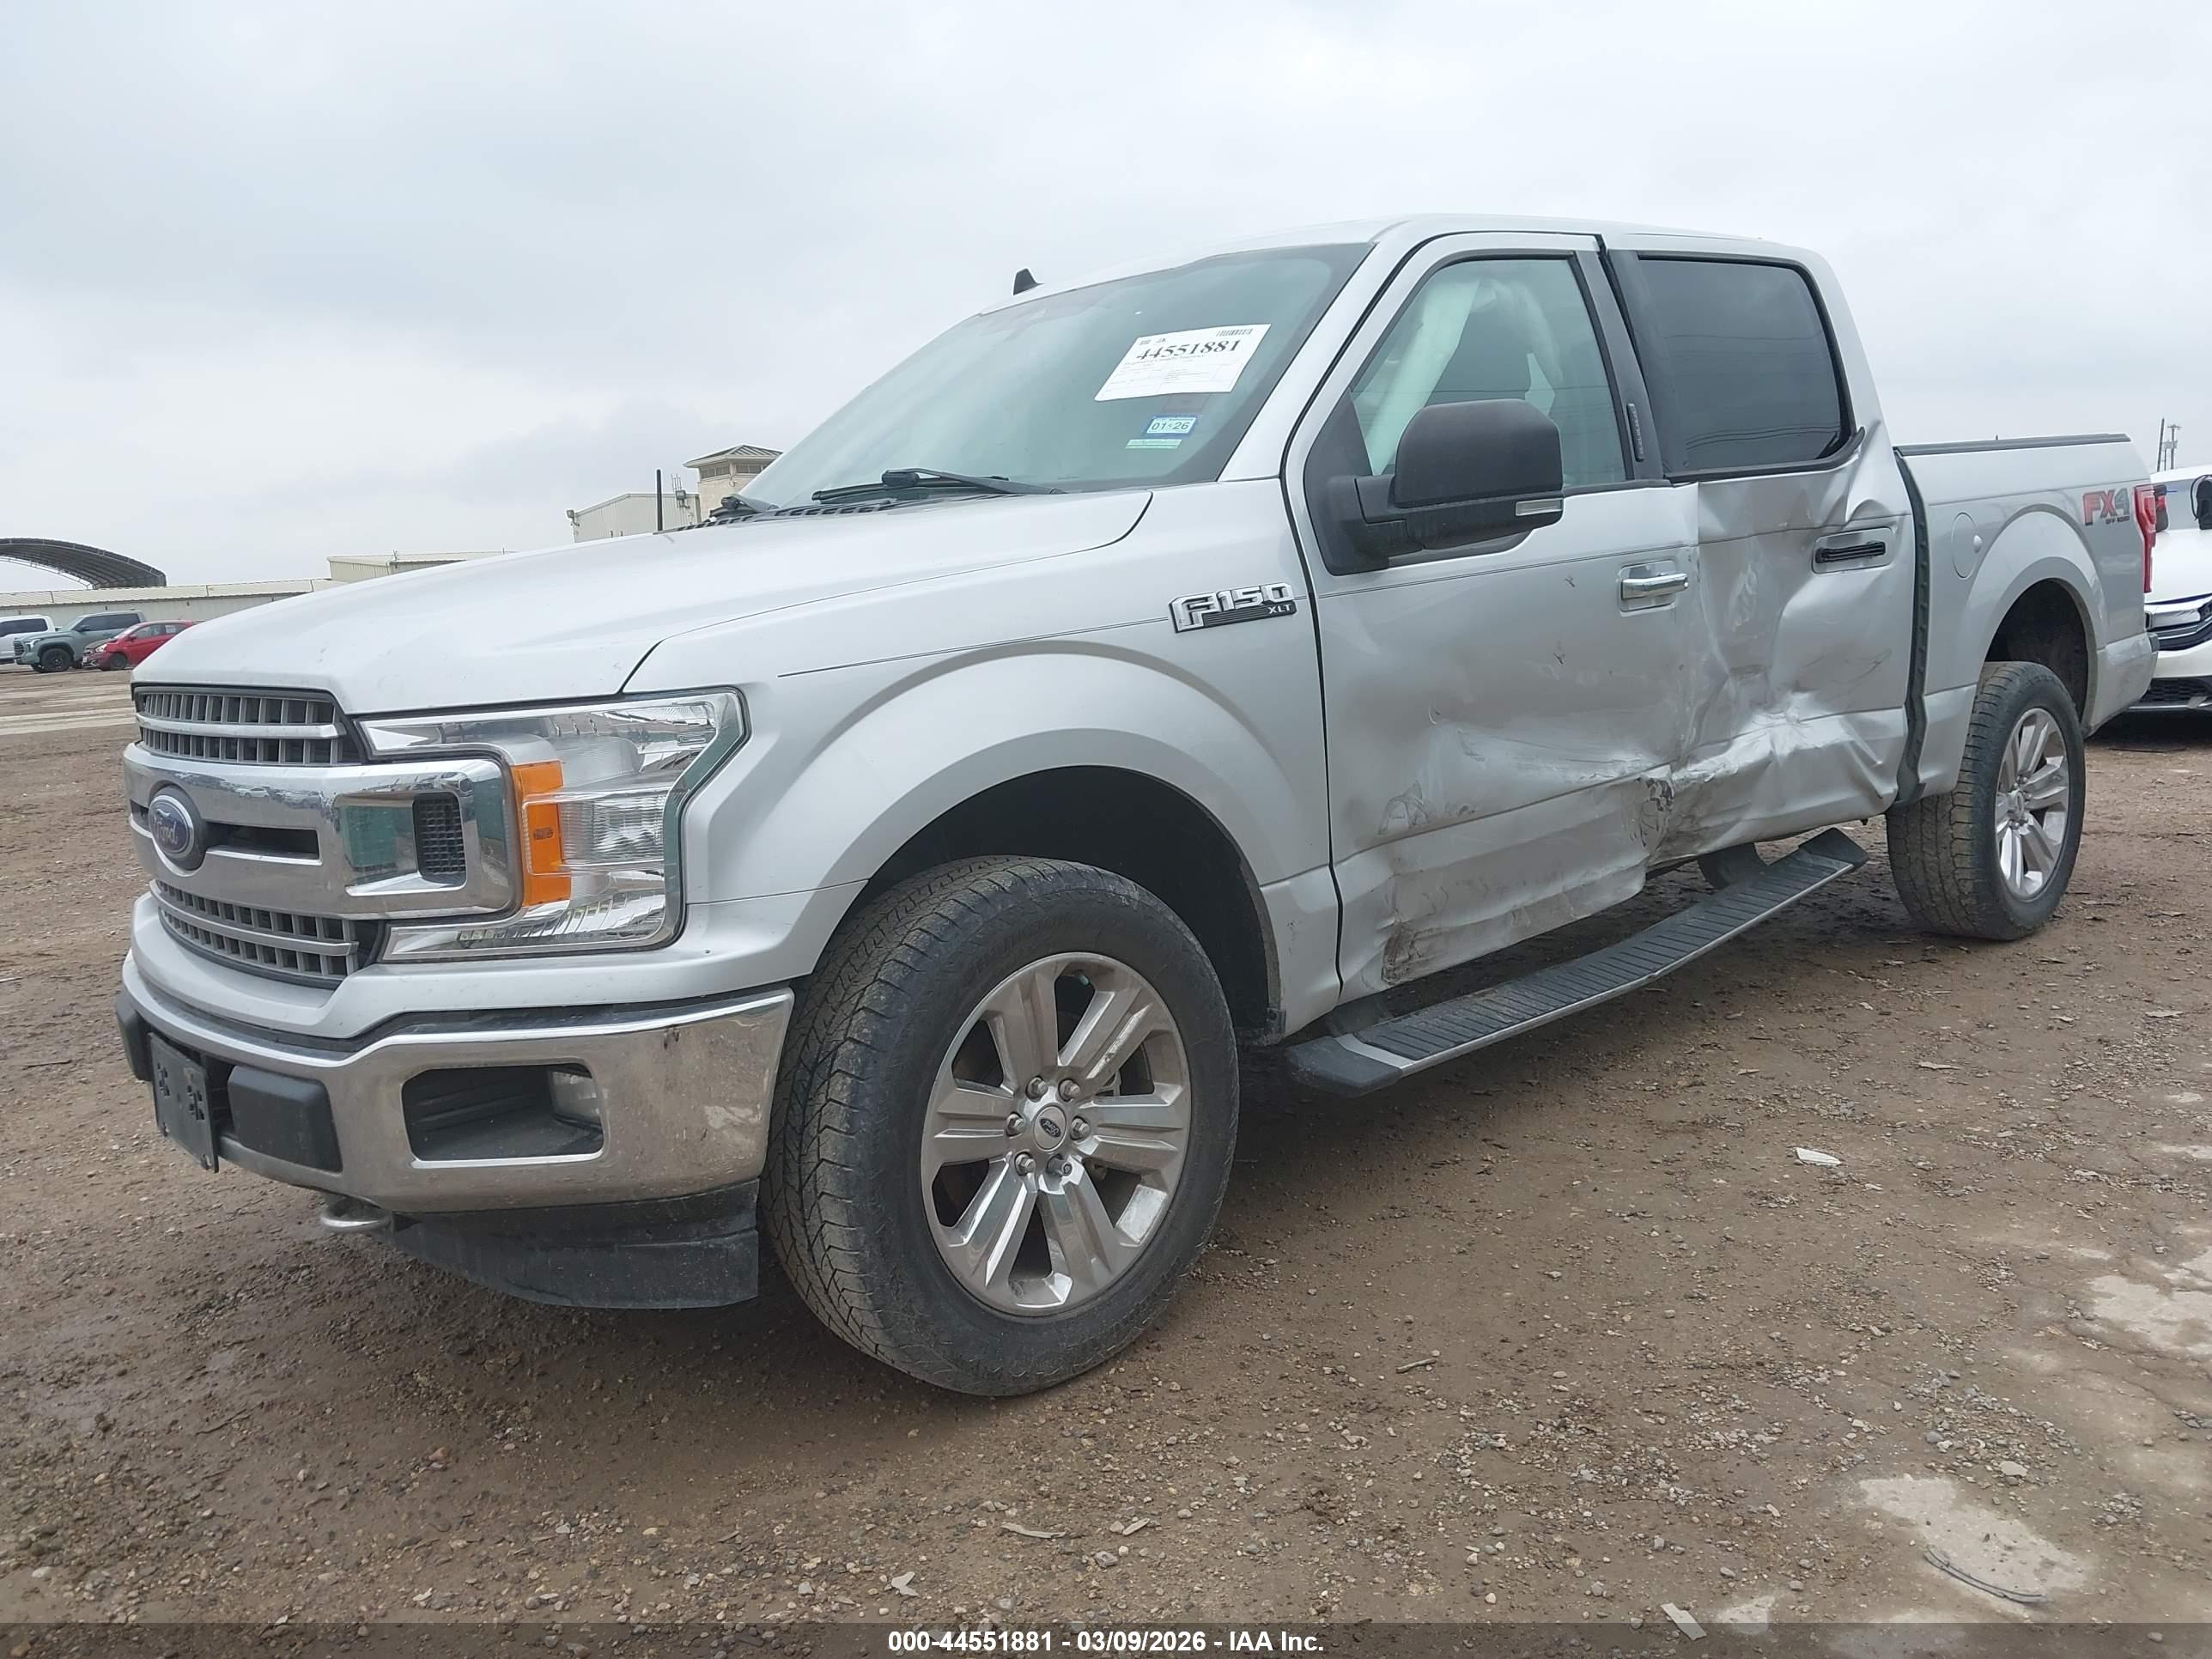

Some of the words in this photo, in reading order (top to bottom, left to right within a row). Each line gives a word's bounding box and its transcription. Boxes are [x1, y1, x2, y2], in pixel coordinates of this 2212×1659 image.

[1136, 339, 1241, 360] 44551881
[1152, 422, 1167, 430] 01
[1172, 421, 1190, 430] 26
[2082, 487, 2130, 526] FX4
[1267, 604, 1292, 615] XLT
